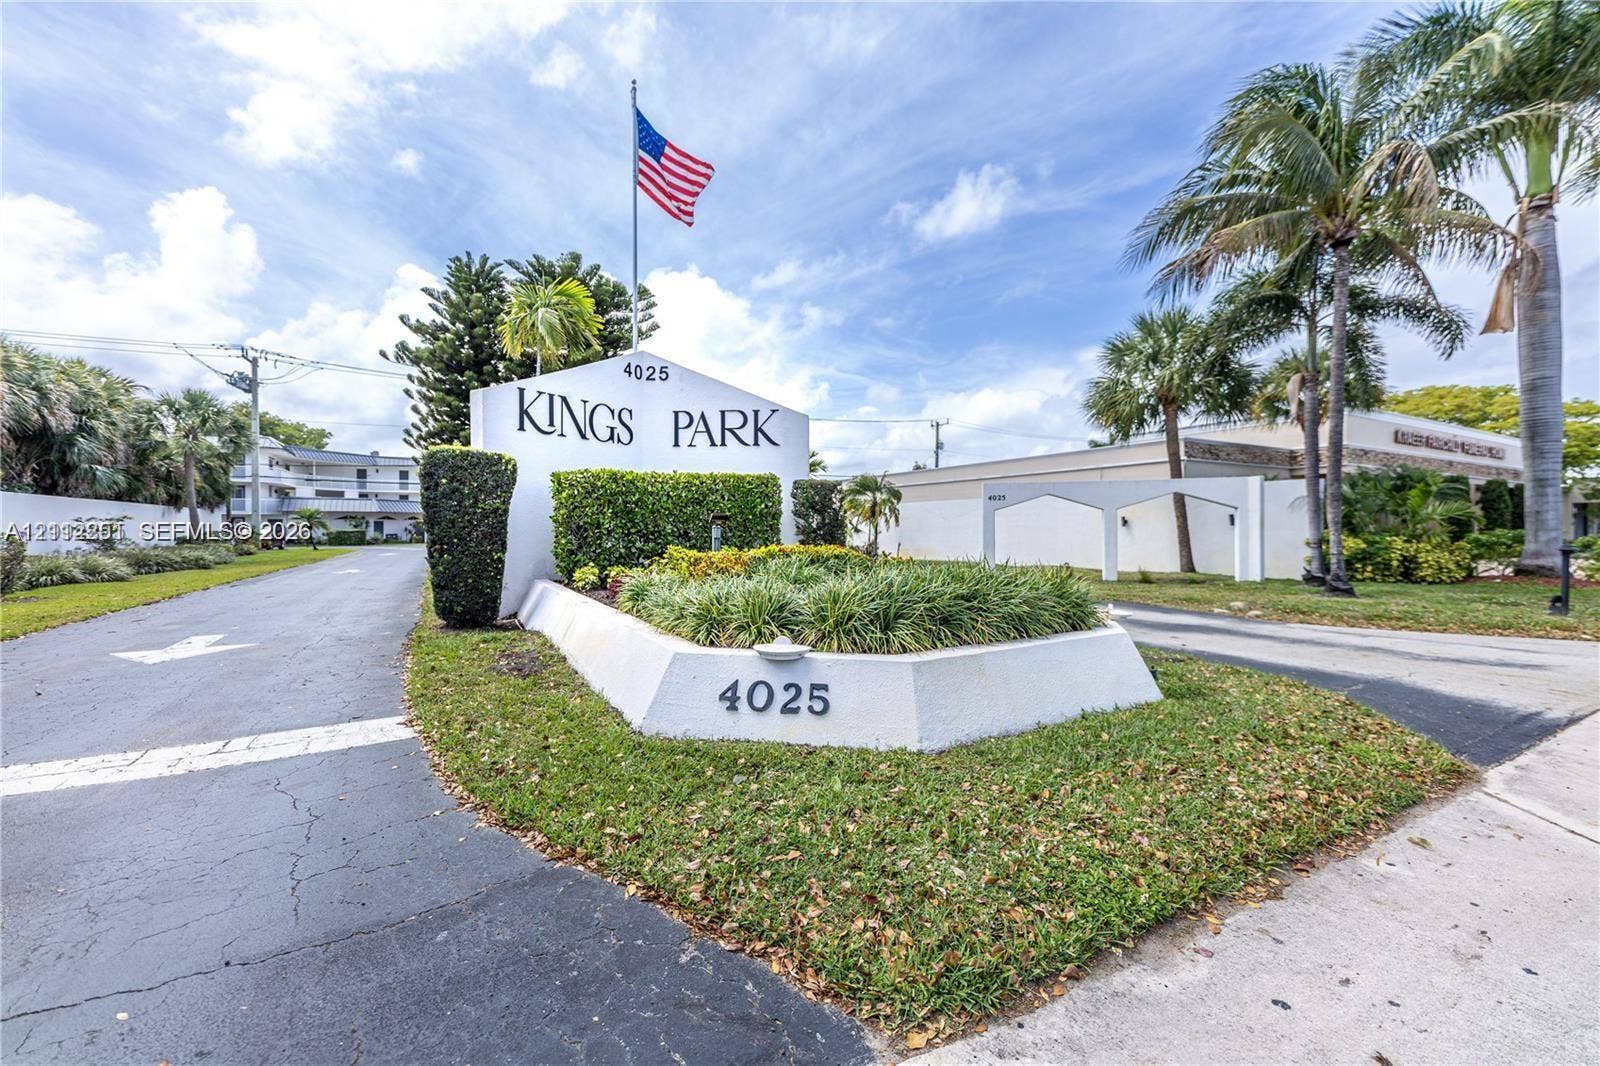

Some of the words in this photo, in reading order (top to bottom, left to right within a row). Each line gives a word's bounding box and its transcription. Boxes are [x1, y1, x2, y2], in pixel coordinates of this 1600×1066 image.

[623, 362, 669, 381] 4025
[517, 387, 634, 446] KINGS
[672, 409, 781, 447] PARK
[718, 679, 831, 716] 4025
